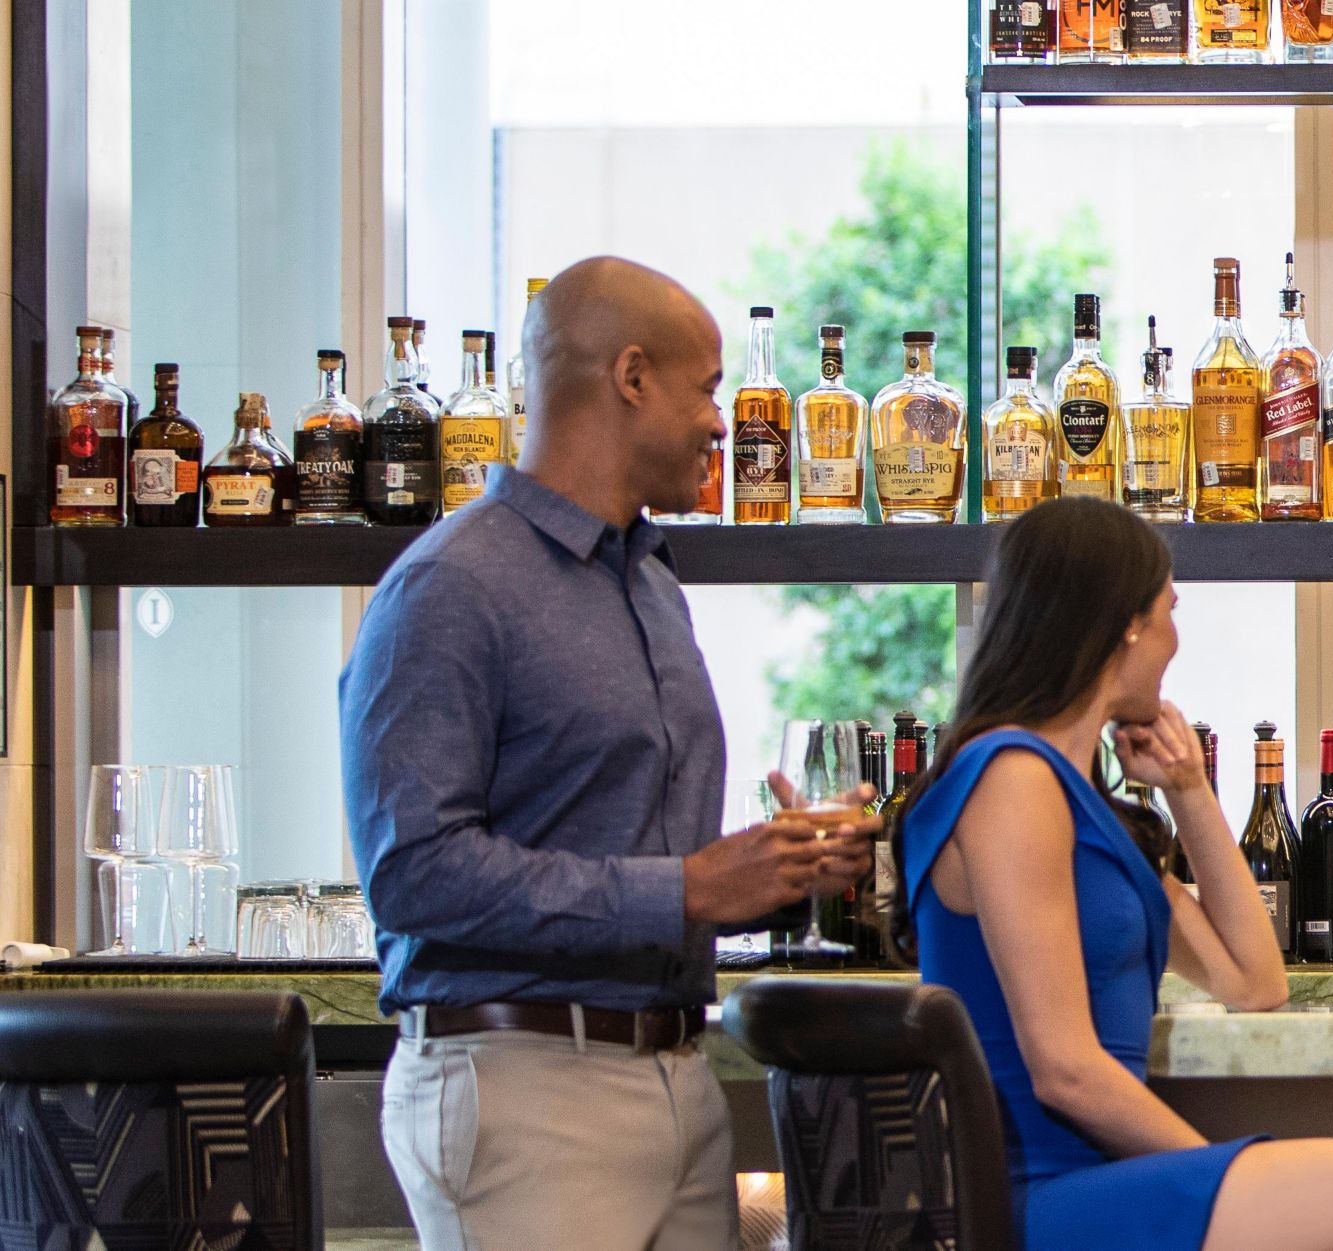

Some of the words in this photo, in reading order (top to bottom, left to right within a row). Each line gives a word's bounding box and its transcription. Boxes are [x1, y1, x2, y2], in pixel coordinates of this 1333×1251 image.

[1265, 407, 1286, 421] Red
[1287, 396, 1313, 414] Label
[1062, 414, 1105, 426] Clontarf
[445, 433, 495, 447] MAGDALENA
[297, 460, 331, 475] TREATY
[332, 459, 355, 474] OAK
[104, 481, 115, 495] 8
[216, 480, 256, 490] PYRAT
